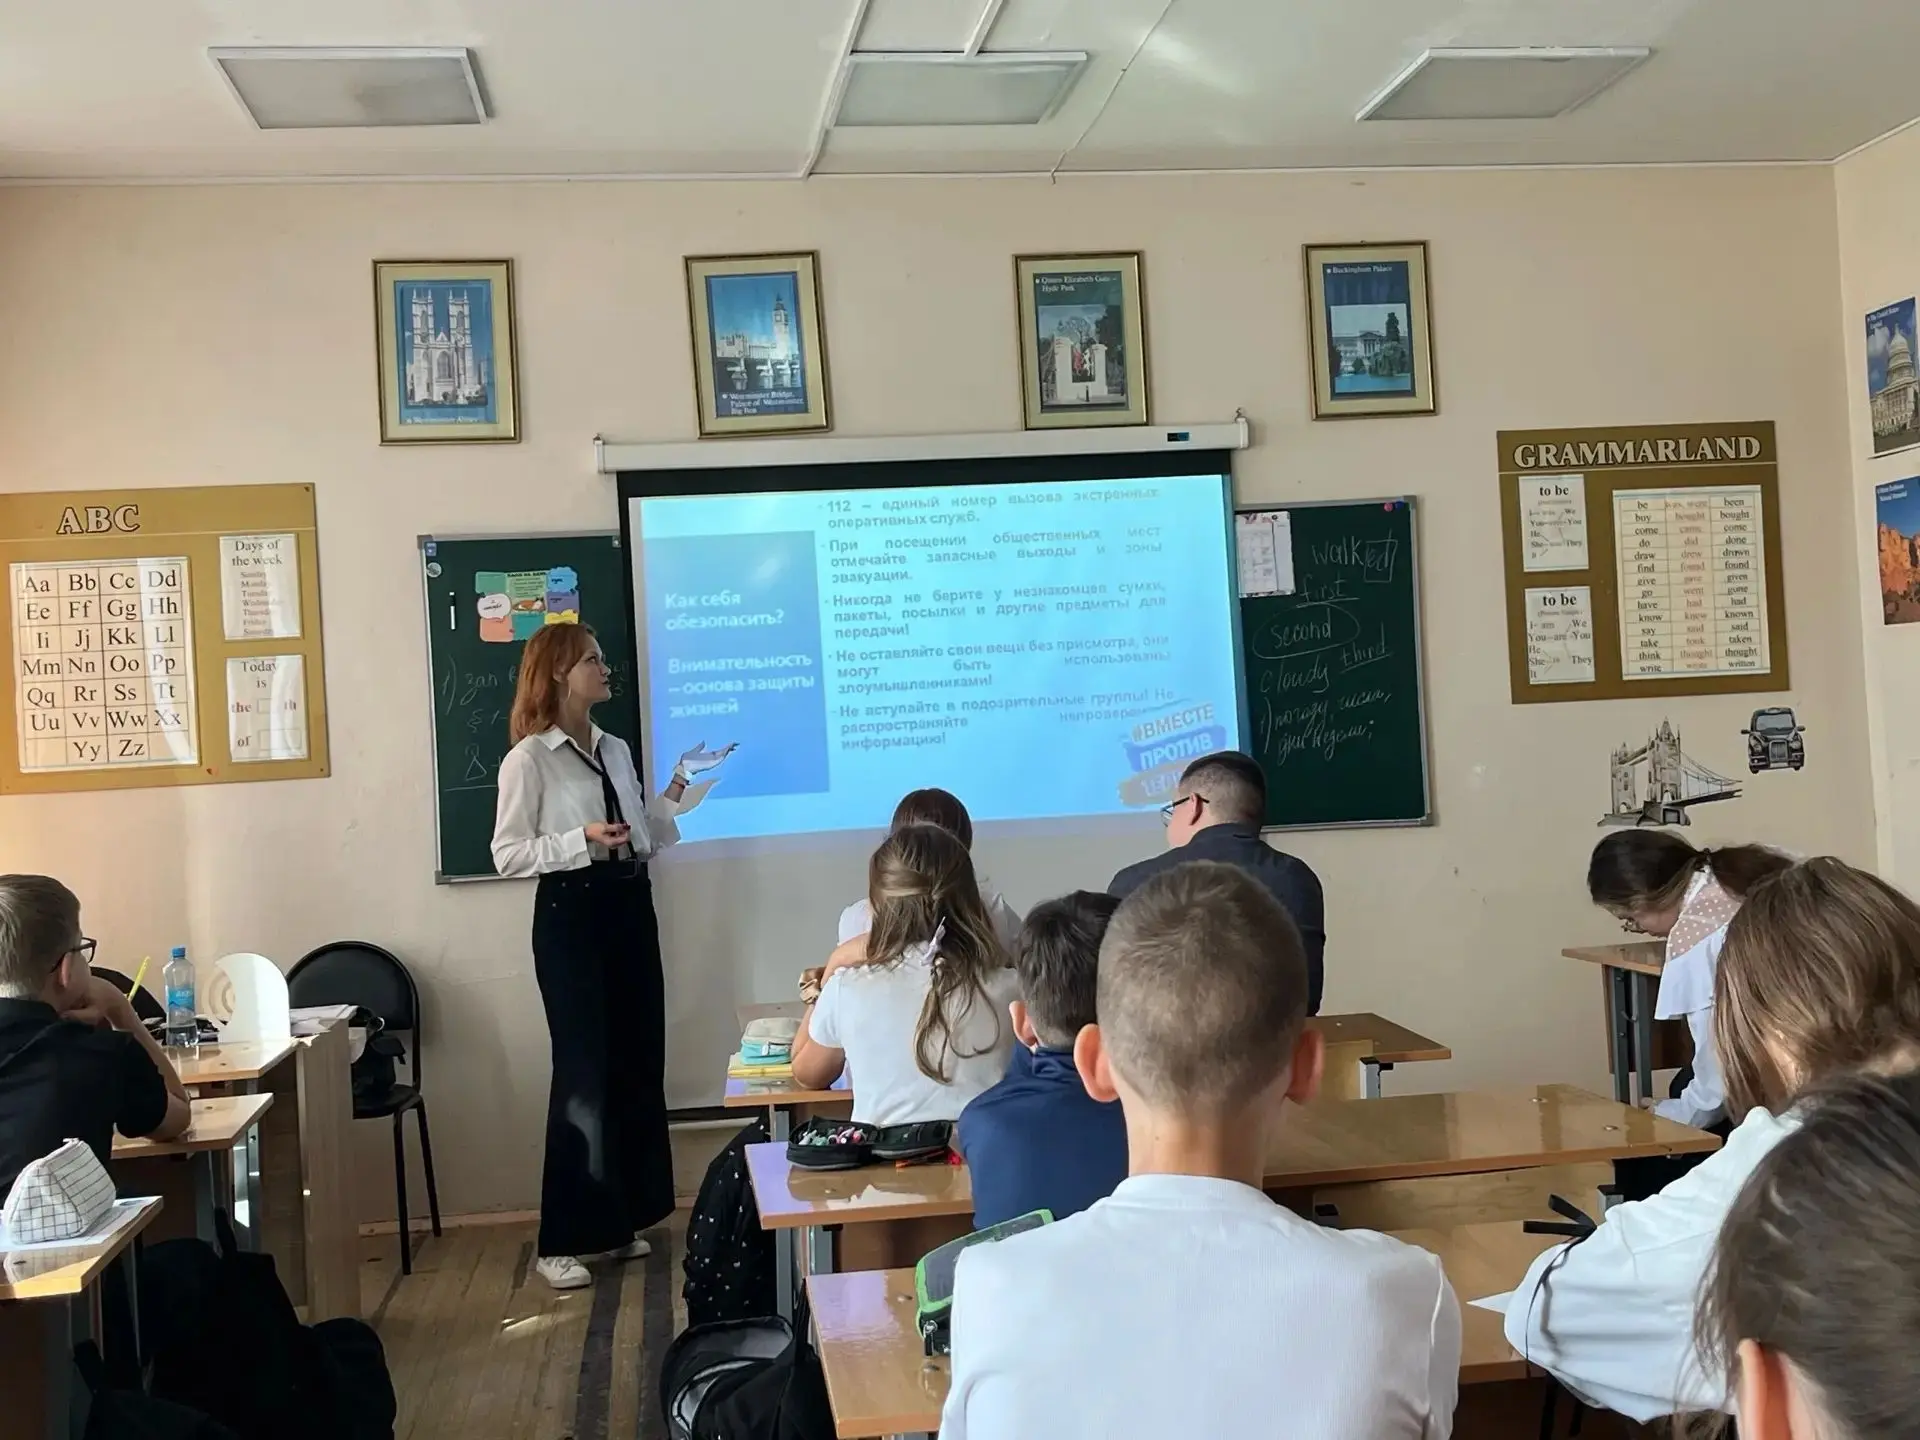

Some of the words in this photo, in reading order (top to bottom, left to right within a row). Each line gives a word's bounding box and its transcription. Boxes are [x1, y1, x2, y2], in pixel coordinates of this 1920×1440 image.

[1513, 435, 1761, 468] GRAMMARLAND
[1540, 486, 1551, 496] to
[1555, 485, 1570, 496] be
[827, 500, 852, 512] 112
[882, 496, 940, 512] единый
[951, 495, 998, 508] номер
[1637, 500, 1648, 510] be
[56, 504, 141, 535] ABC
[828, 515, 927, 530] оперативных
[930, 510, 980, 526] служб.
[1634, 526, 1658, 536] come
[235, 540, 265, 553] Days
[829, 539, 858, 554] При
[884, 535, 967, 550] посещении
[232, 556, 250, 566] the
[24, 576, 50, 593] Aa
[69, 573, 96, 592] Bb
[110, 572, 135, 590] Cc
[148, 569, 176, 588] Dd
[665, 592, 698, 608] Как
[701, 589, 742, 606] себя
[832, 594, 892, 608] Никогда
[904, 592, 922, 603] не
[932, 589, 984, 605] берите
[1543, 595, 1556, 606] to
[1560, 592, 1577, 606] be
[26, 602, 50, 620] Ee
[69, 600, 92, 618] Ff
[107, 599, 137, 621] Gg
[150, 596, 178, 616] Hh
[902, 606, 966, 620] посылки
[665, 608, 785, 630] обезопасить?
[36, 632, 50, 649] Ii
[75, 629, 90, 652] Jj
[108, 627, 137, 646] Kk
[156, 626, 174, 643] Ll
[834, 624, 910, 640] передачи!
[836, 650, 856, 662] Не
[947, 646, 982, 656] свои
[22, 659, 61, 676] Mm
[68, 656, 96, 674] Nn
[110, 654, 140, 672] Oo
[152, 654, 176, 674] Pp
[668, 654, 812, 674] Внимательность
[836, 666, 880, 681] могут
[256, 676, 268, 689] is
[682, 679, 744, 694] основа
[748, 676, 815, 693] защиты
[27, 686, 56, 708] Qq
[74, 685, 97, 702] Rr
[114, 683, 137, 701] Ss
[155, 682, 176, 699] Tt
[669, 698, 739, 718] жизней
[840, 706, 860, 718] Не
[32, 714, 60, 732] Uu
[72, 712, 100, 728] Vv
[106, 710, 148, 728] Ww
[154, 708, 182, 726] Xx
[1132, 702, 1215, 742] #ВМЕСТЕ
[73, 740, 101, 762] Yy
[118, 738, 146, 757] Zz
[236, 736, 252, 747] of
[1140, 732, 1214, 770] ПРОТИВ
